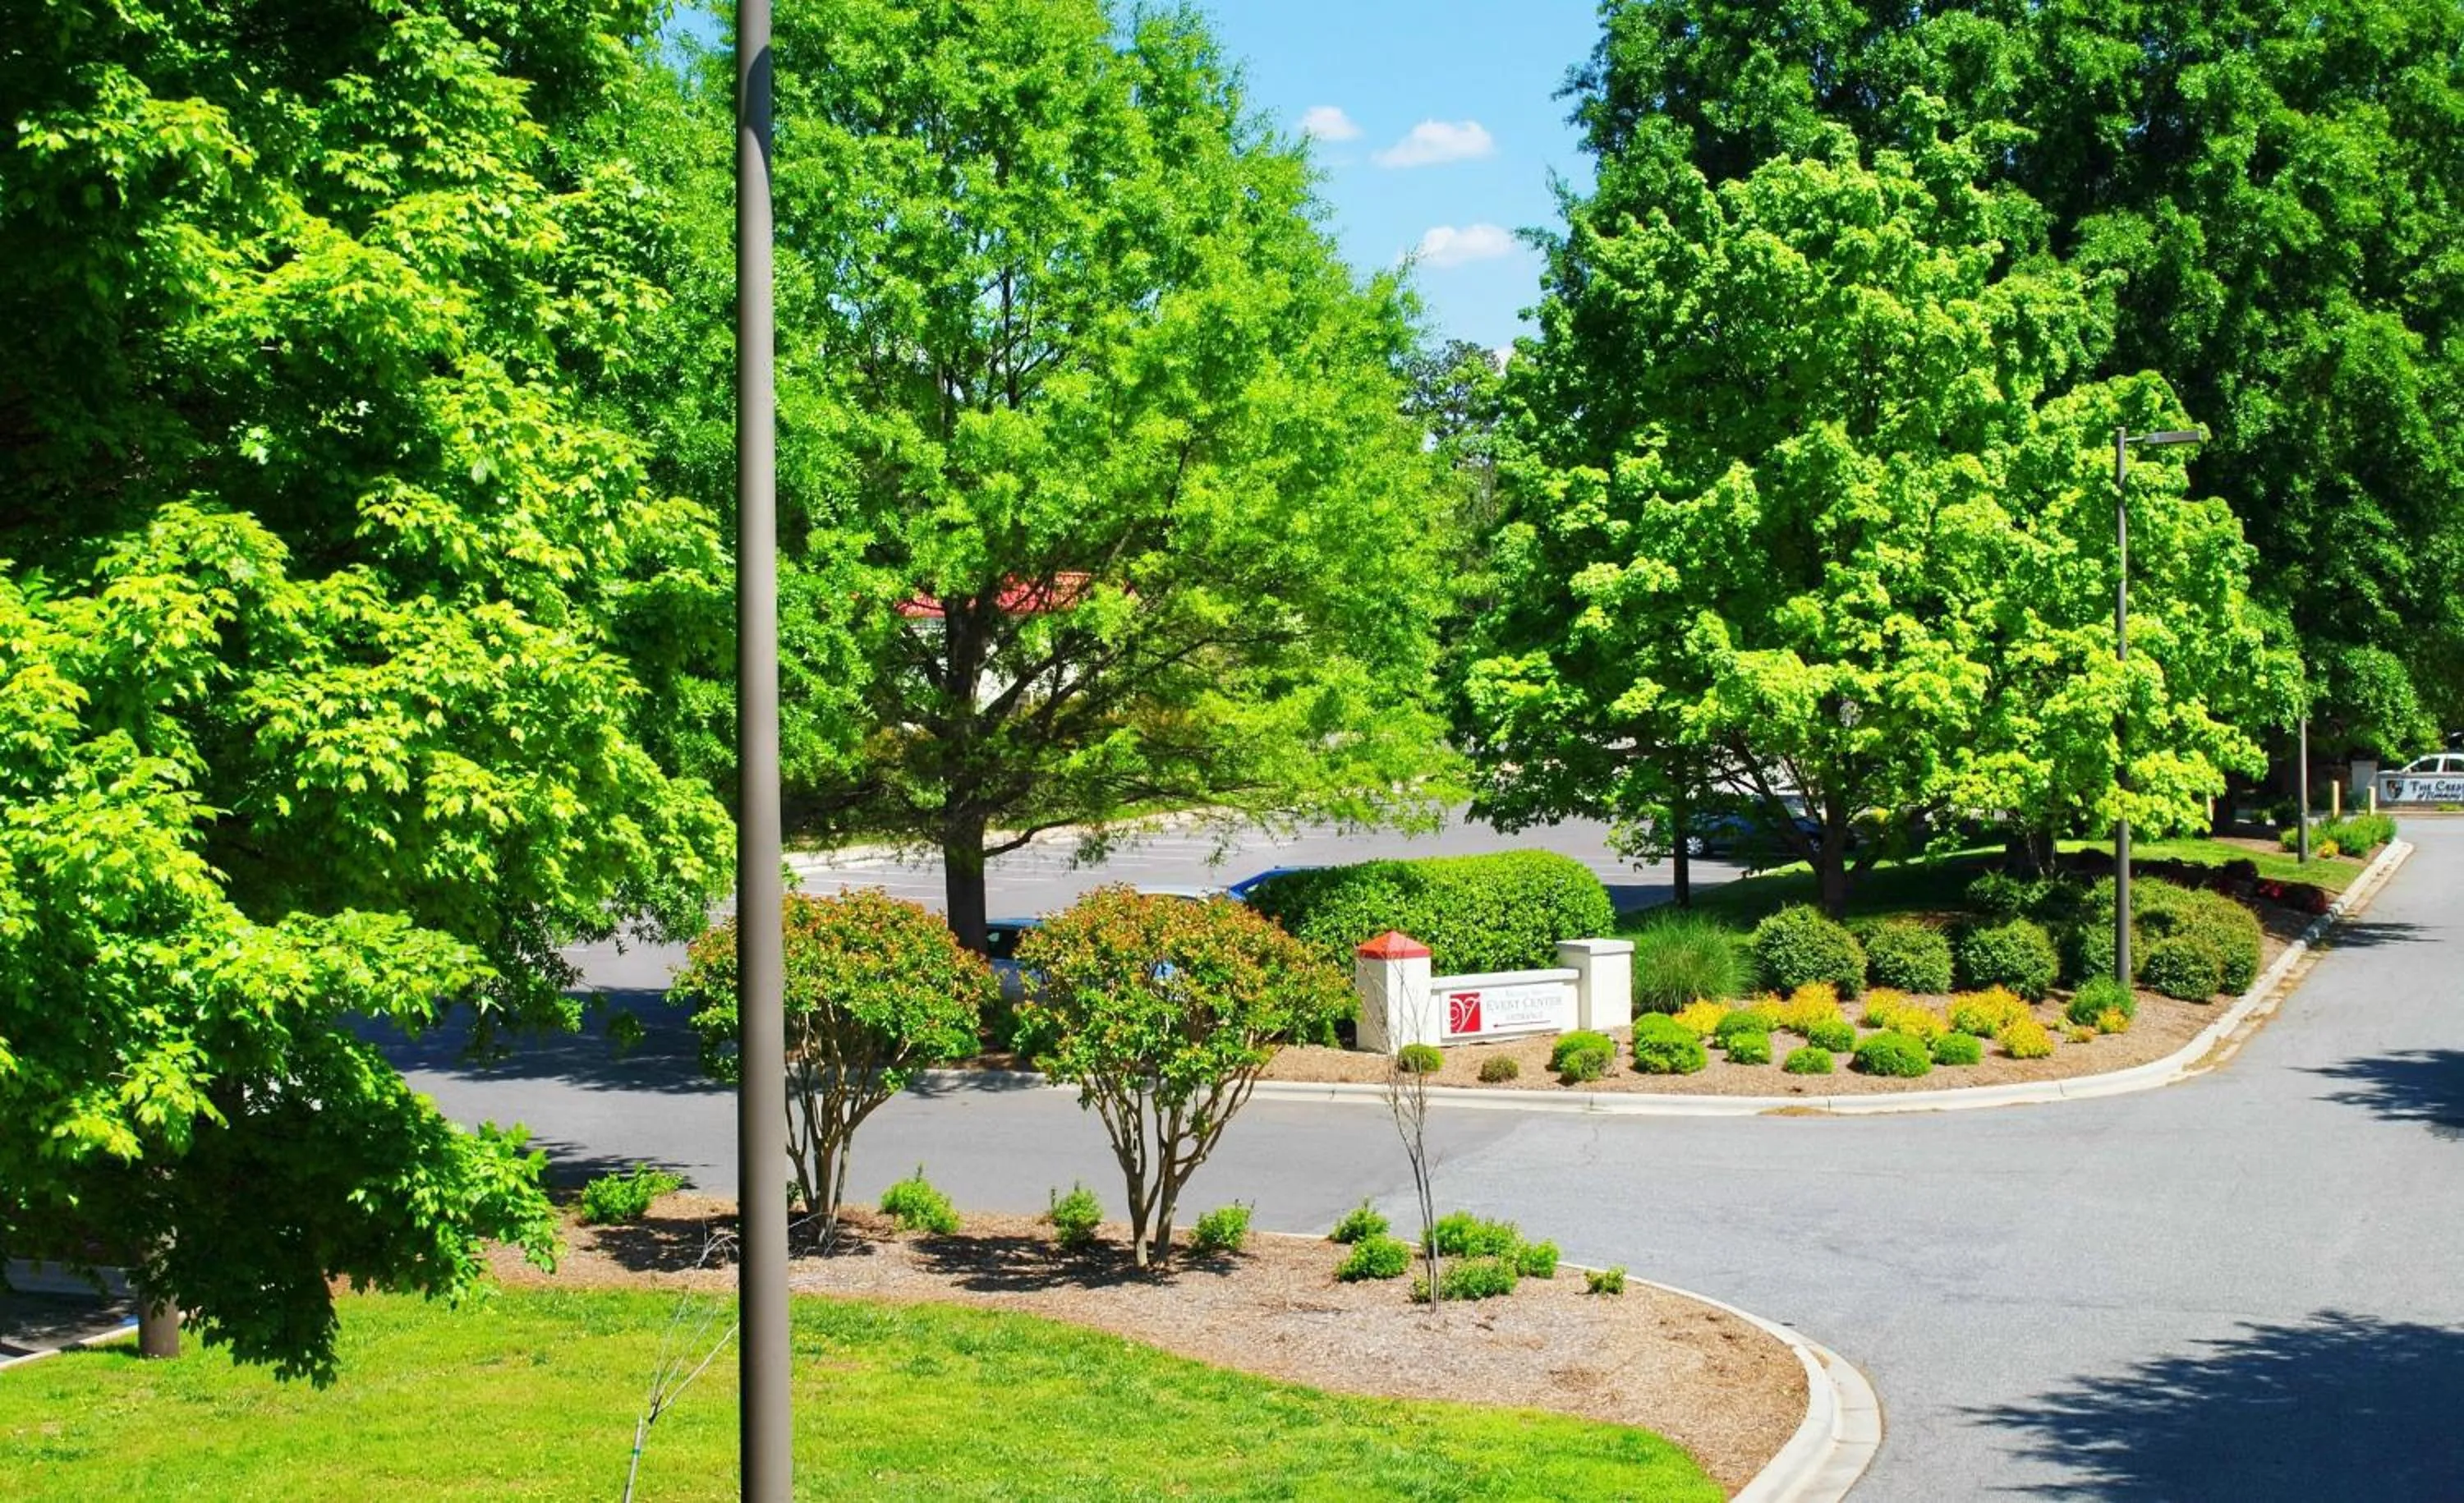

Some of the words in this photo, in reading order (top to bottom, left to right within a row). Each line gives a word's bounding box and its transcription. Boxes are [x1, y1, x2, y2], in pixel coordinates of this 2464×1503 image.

[2435, 780, 2464, 791] CRES
[1486, 999, 1520, 1011] EVENT
[1522, 995, 1562, 1008] CENTER
